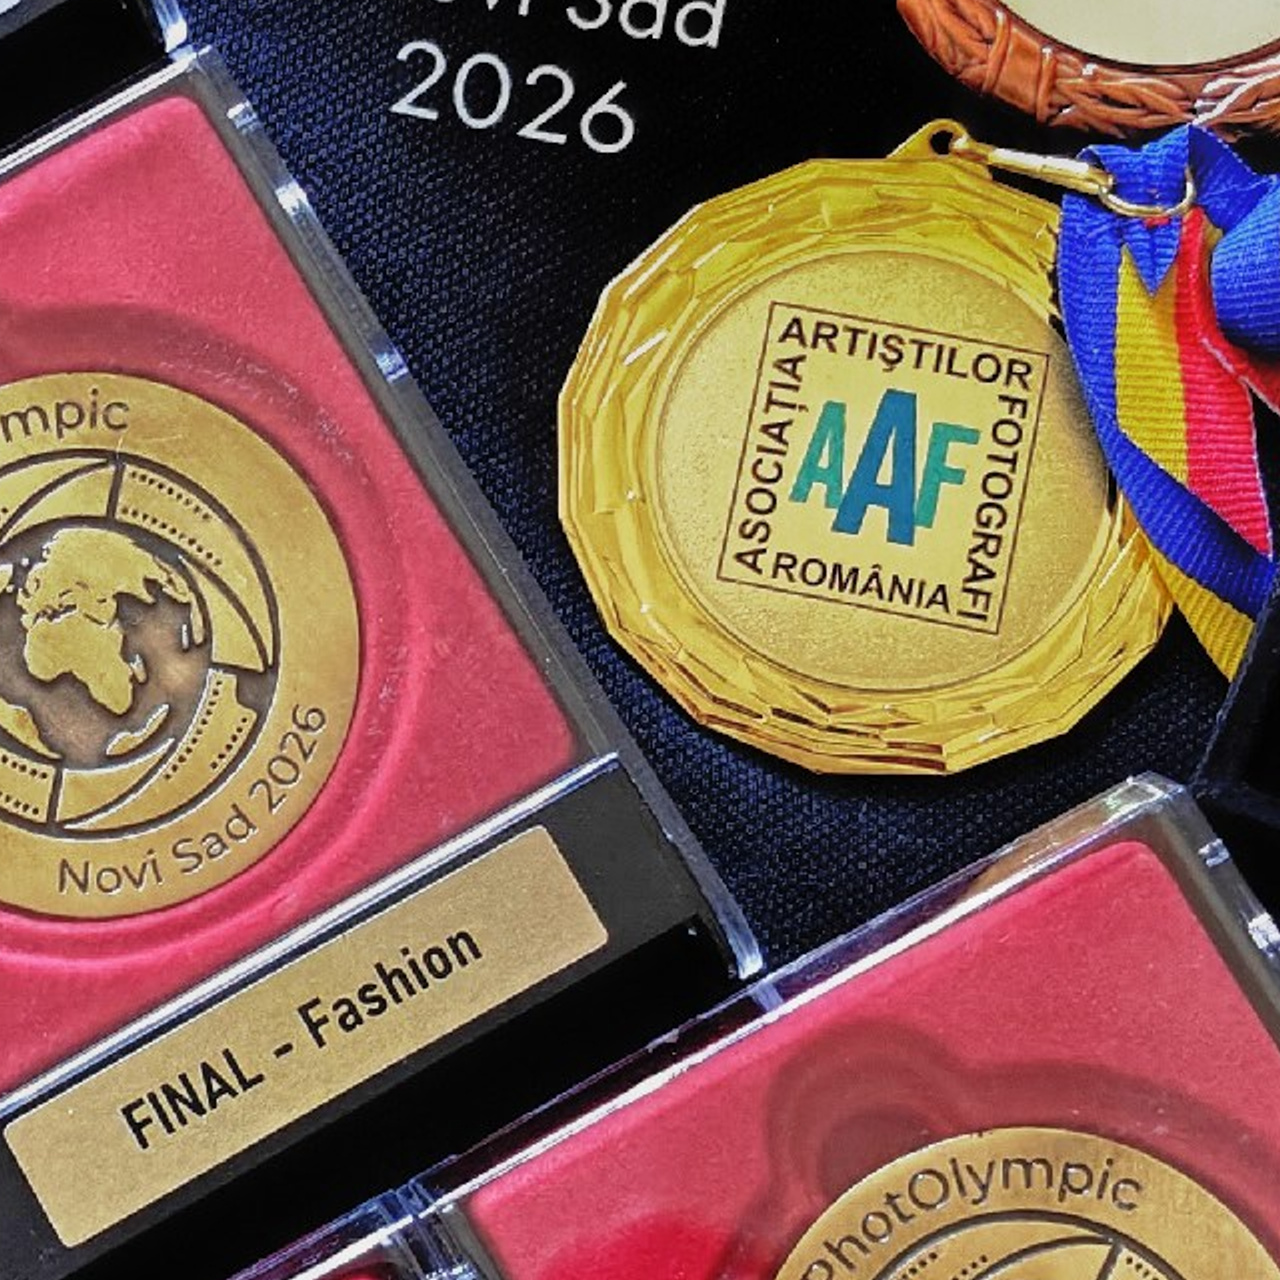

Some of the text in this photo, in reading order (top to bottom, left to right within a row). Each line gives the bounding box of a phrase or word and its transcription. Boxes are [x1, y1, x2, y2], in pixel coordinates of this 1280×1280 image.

[390, 40, 636, 154] 2026
[788, 388, 981, 546] AAF
[957, 394, 1028, 623] FOTOGRAFI
[771, 551, 951, 614] ROMÂNIA
[58, 704, 328, 897] Novi Sad 2026
[120, 926, 483, 1151] FINAL - Fashion
